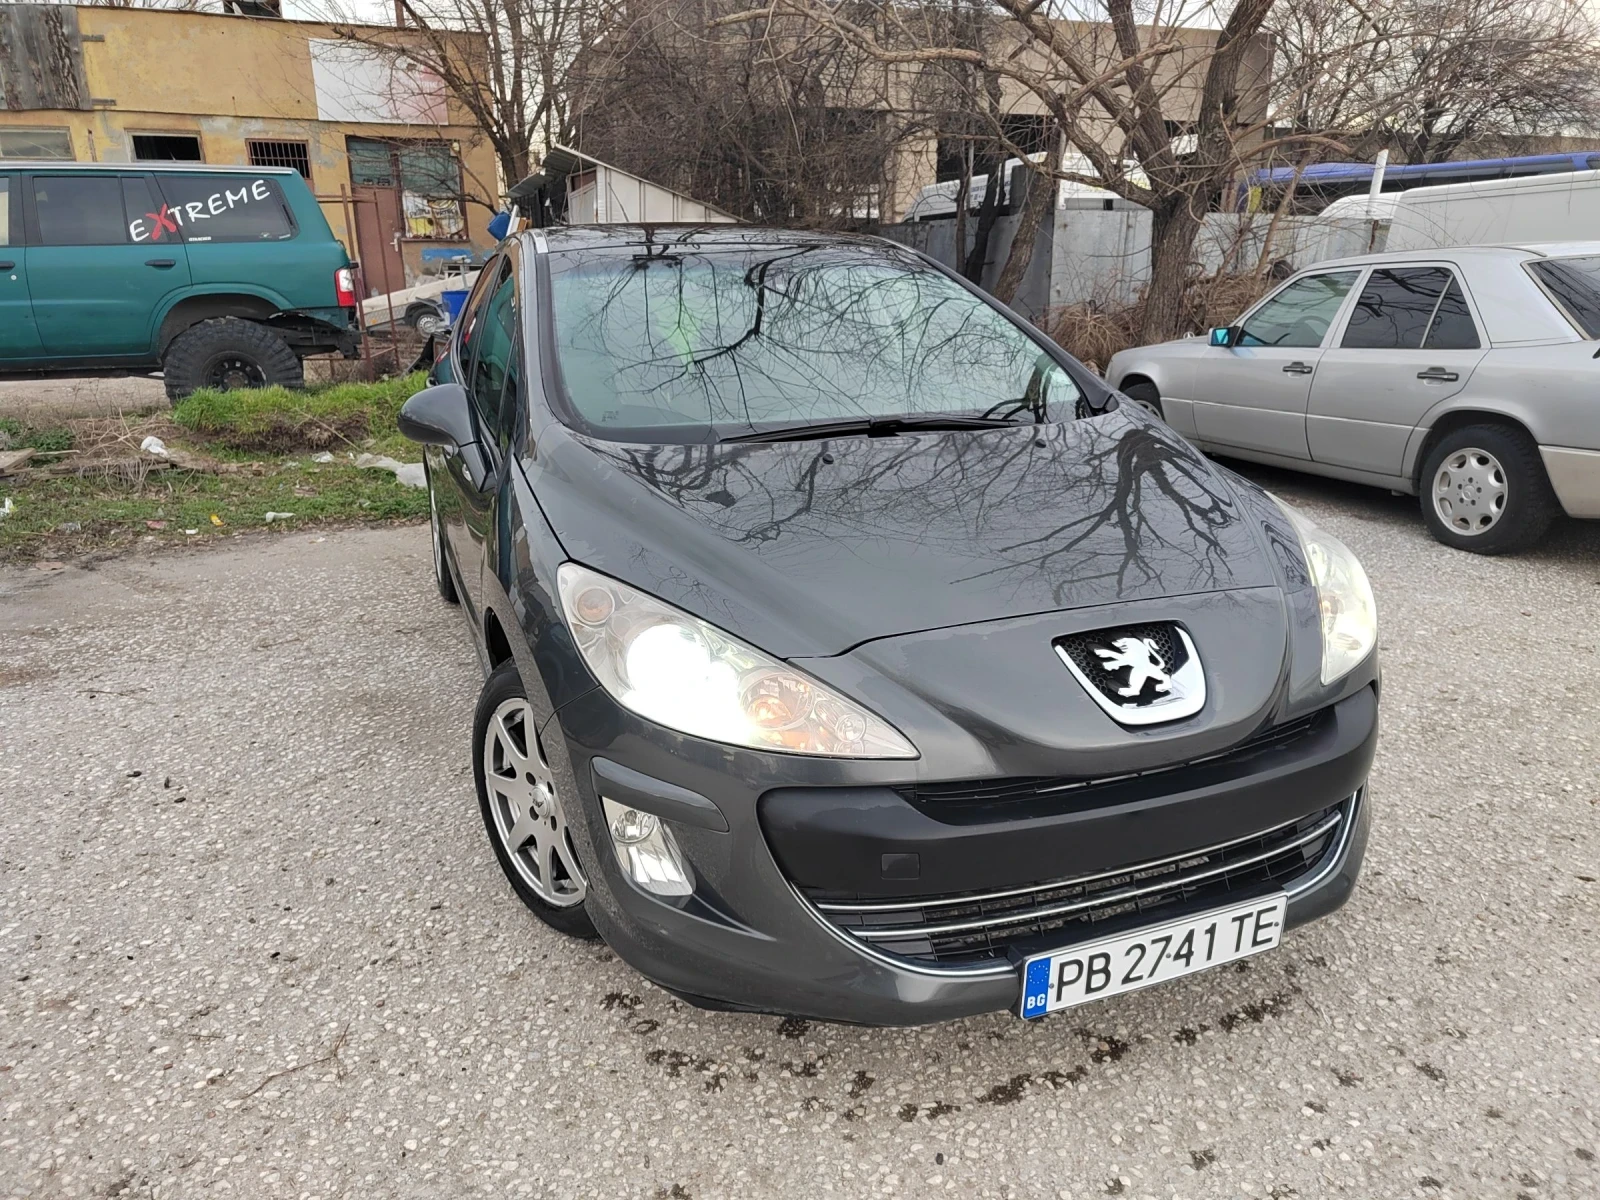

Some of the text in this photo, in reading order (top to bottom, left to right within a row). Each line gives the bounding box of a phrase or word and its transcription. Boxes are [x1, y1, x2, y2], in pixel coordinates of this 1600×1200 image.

[129, 179, 271, 242] EXTREME
[1055, 905, 1278, 1002] PB 2741 TE
[1026, 993, 1046, 1009] BG
